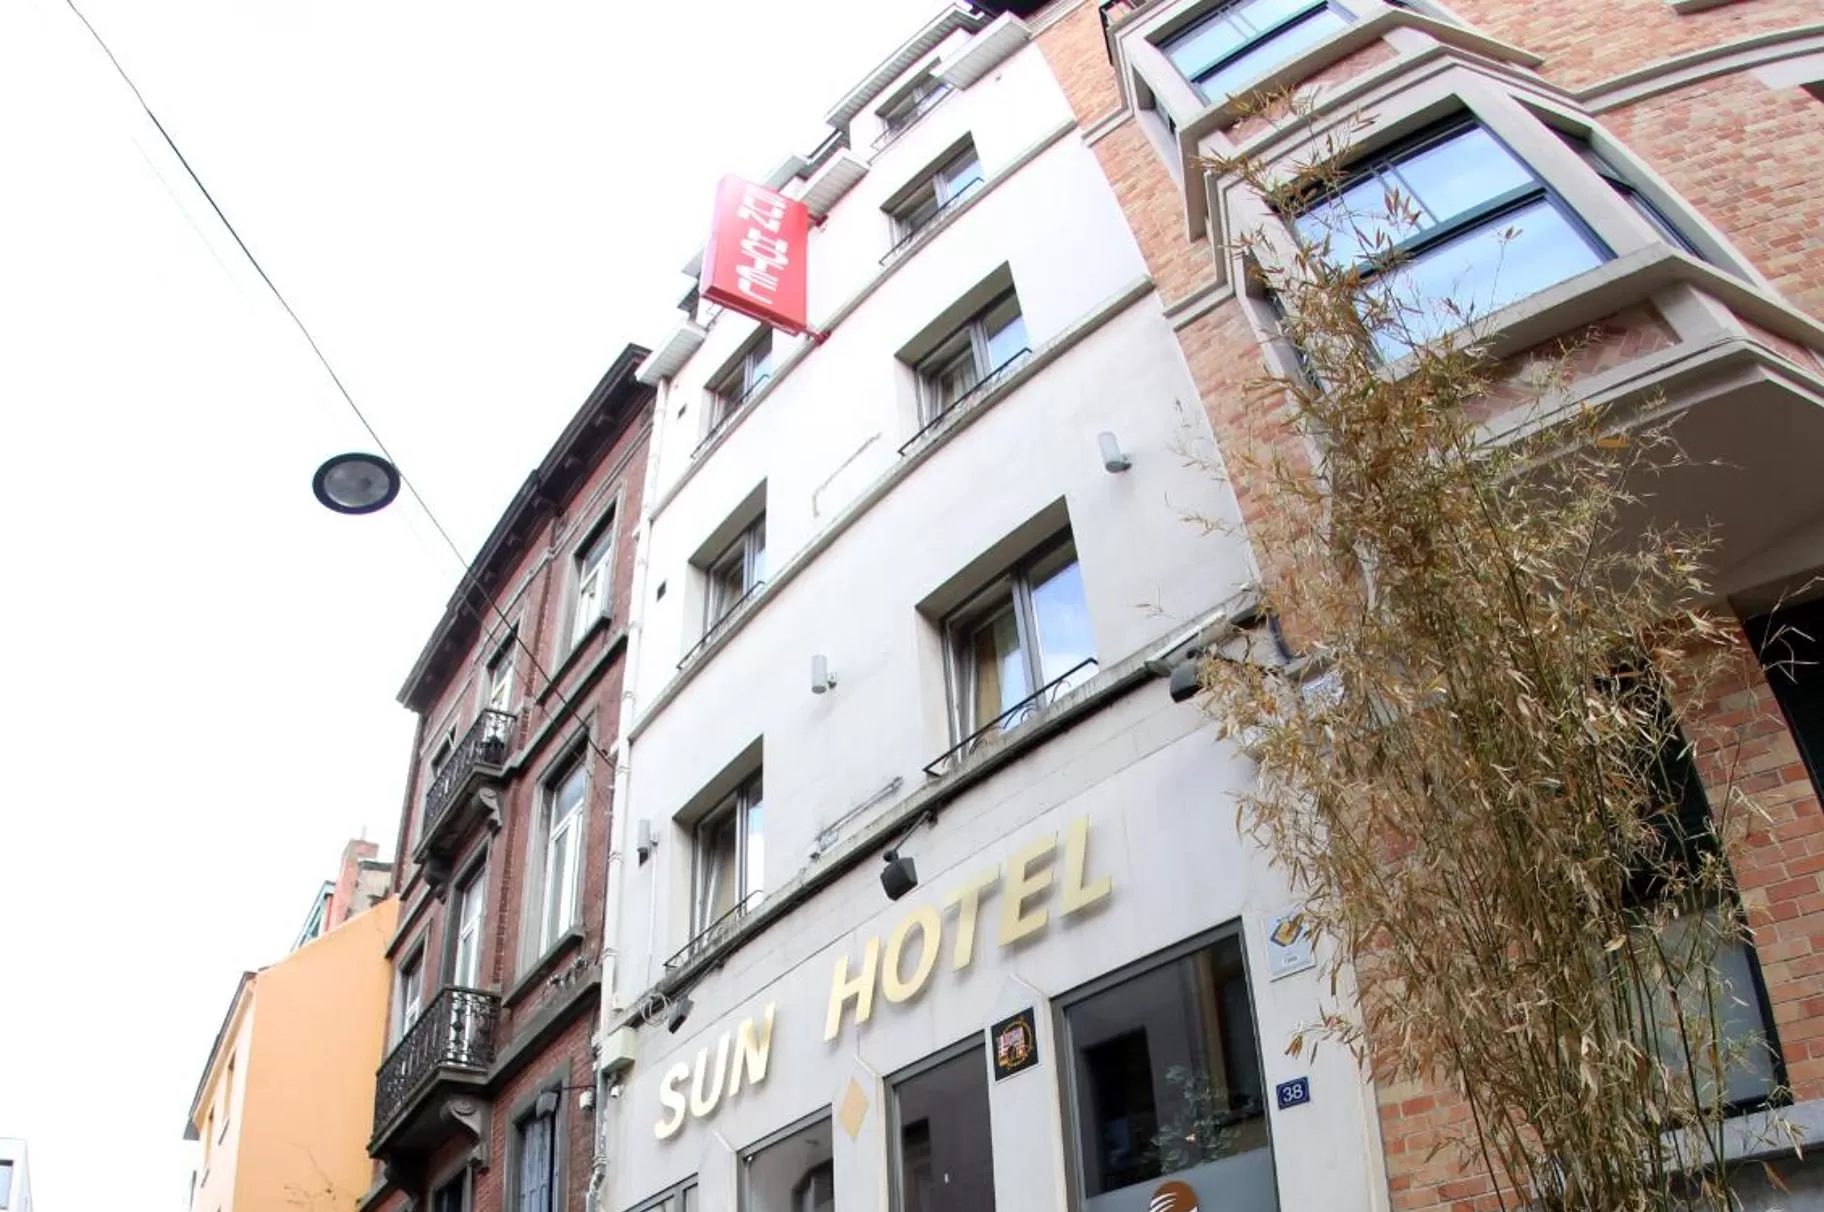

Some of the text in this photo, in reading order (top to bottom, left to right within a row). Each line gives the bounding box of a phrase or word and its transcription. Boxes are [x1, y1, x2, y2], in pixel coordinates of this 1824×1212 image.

[653, 815, 1113, 1140] SUN HOTEL
[1282, 1083, 1303, 1102] 38
